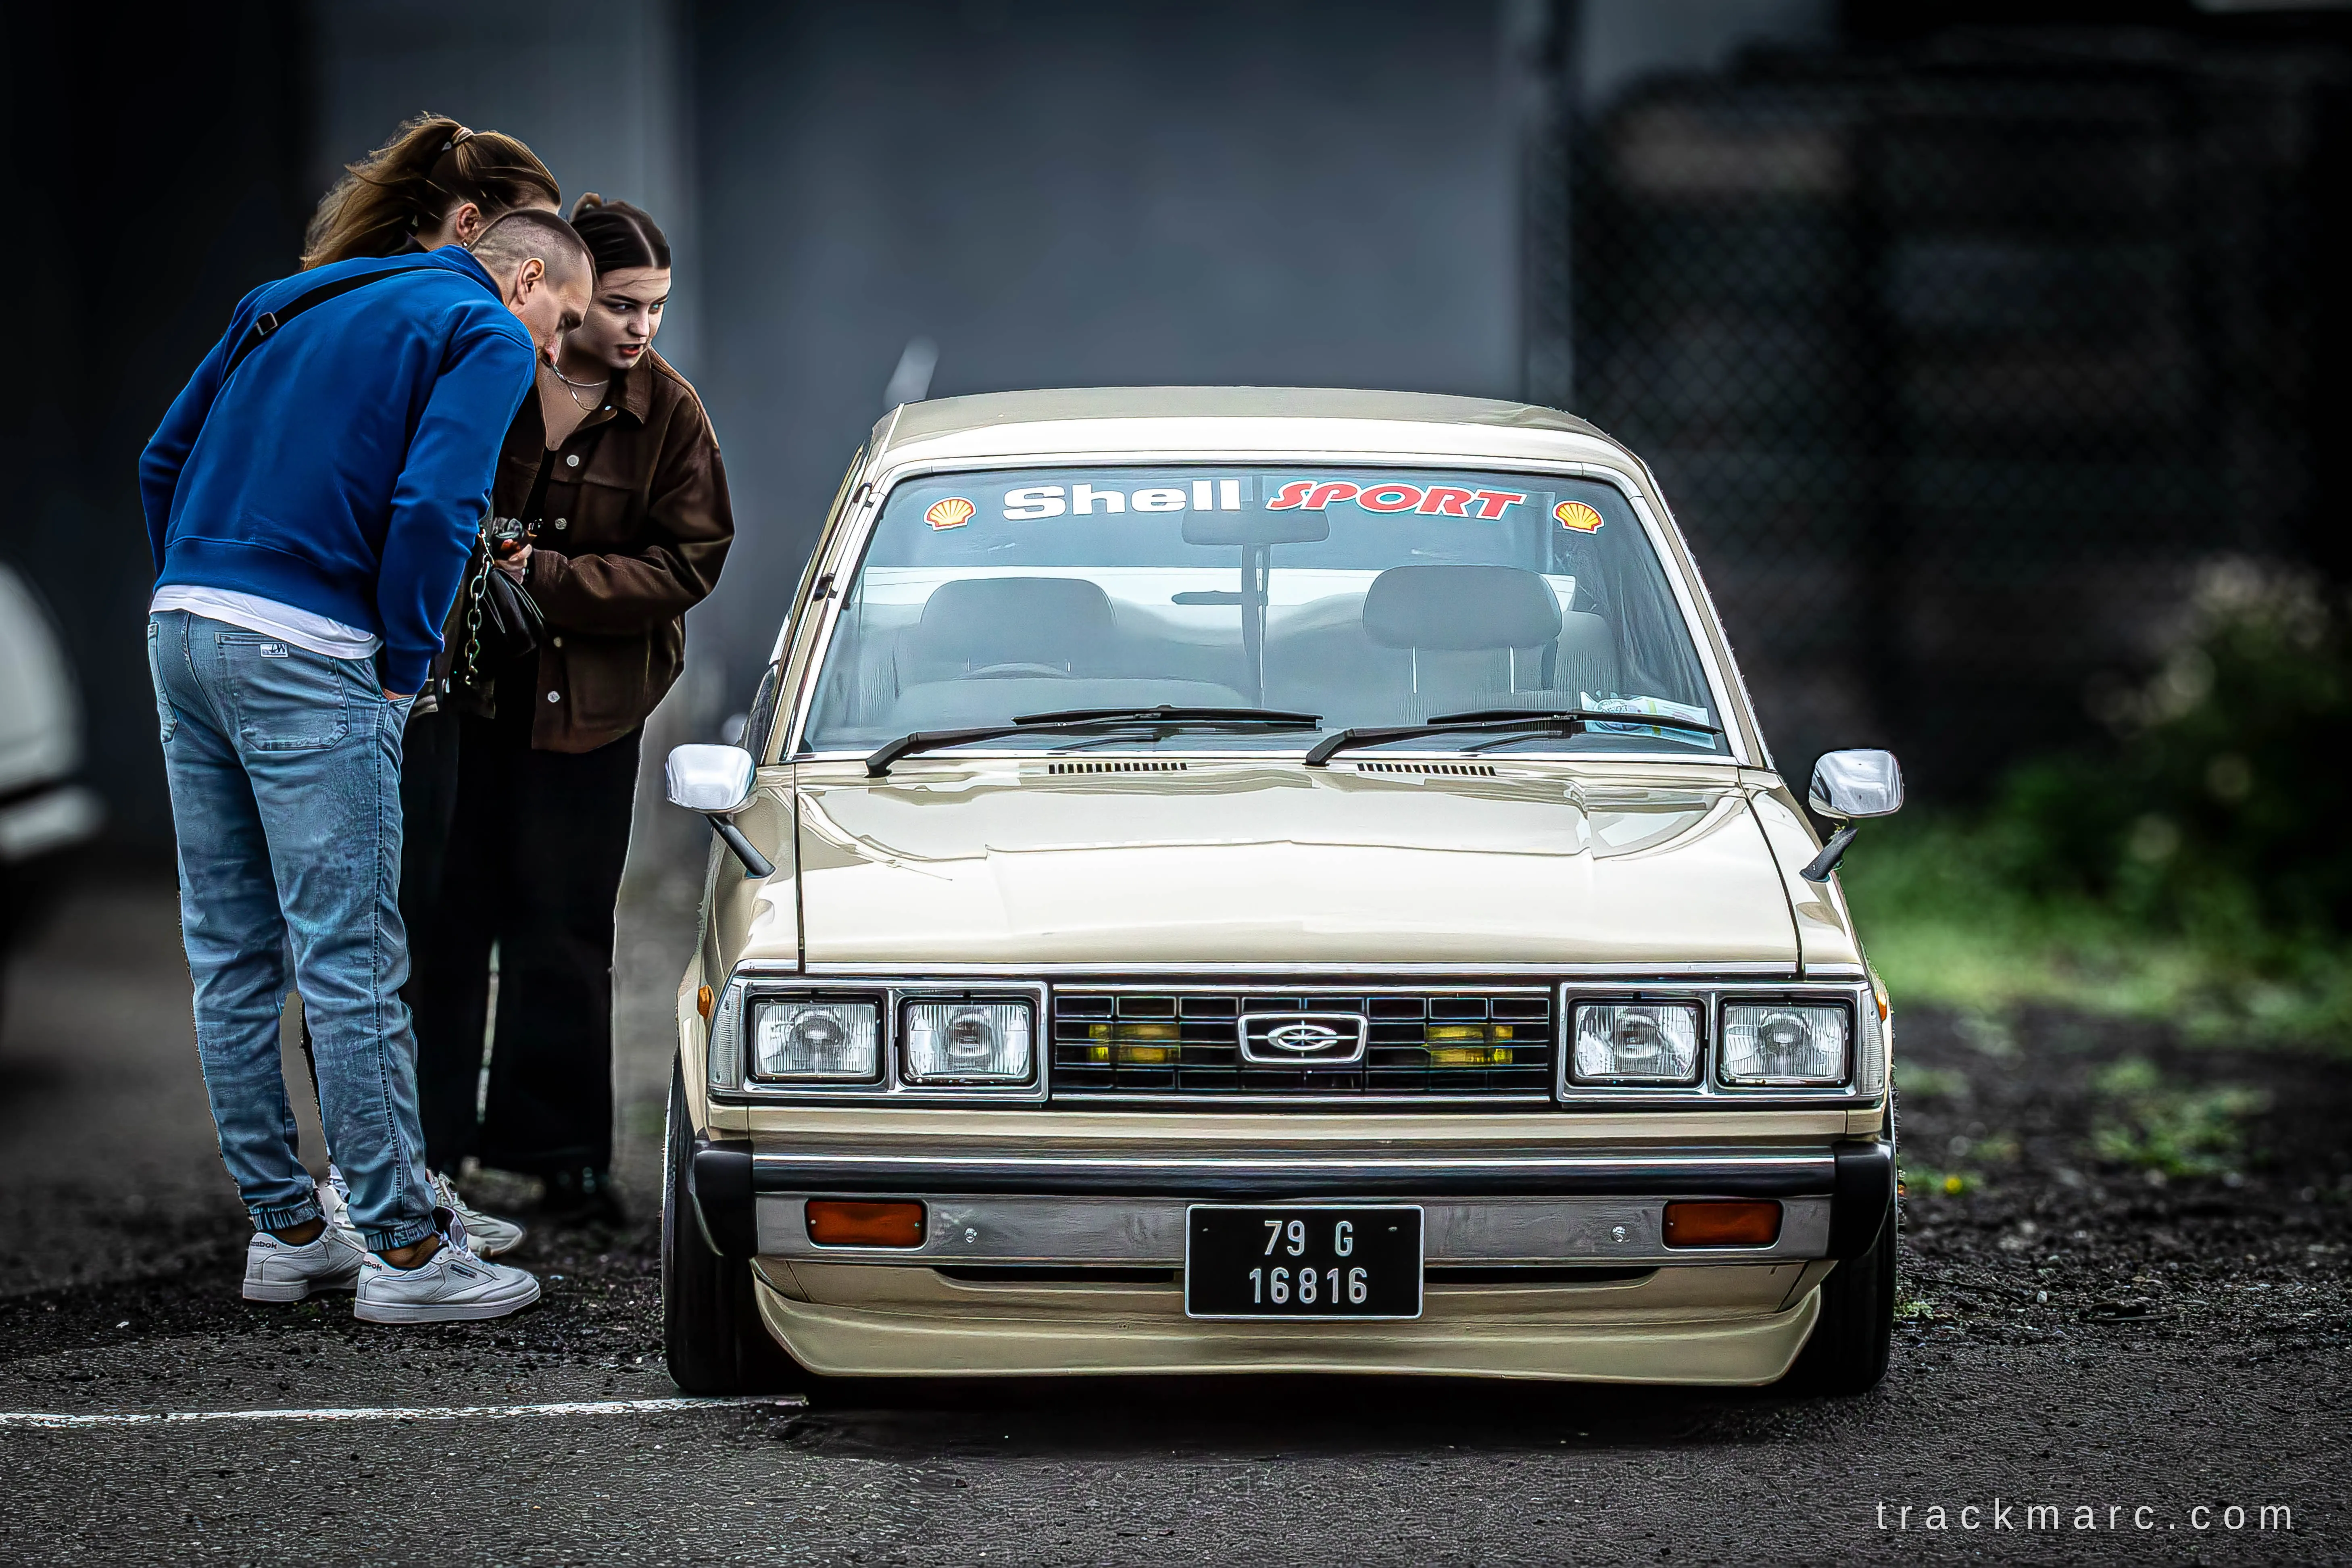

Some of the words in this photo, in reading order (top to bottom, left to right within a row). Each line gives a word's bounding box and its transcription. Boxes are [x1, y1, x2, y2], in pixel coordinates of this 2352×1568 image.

[1003, 480, 1241, 520] Shell
[1265, 481, 1528, 520] SPORT
[1264, 1220, 1305, 1256] 79
[1335, 1221, 1353, 1257] G
[1249, 1267, 1367, 1304] 16816
